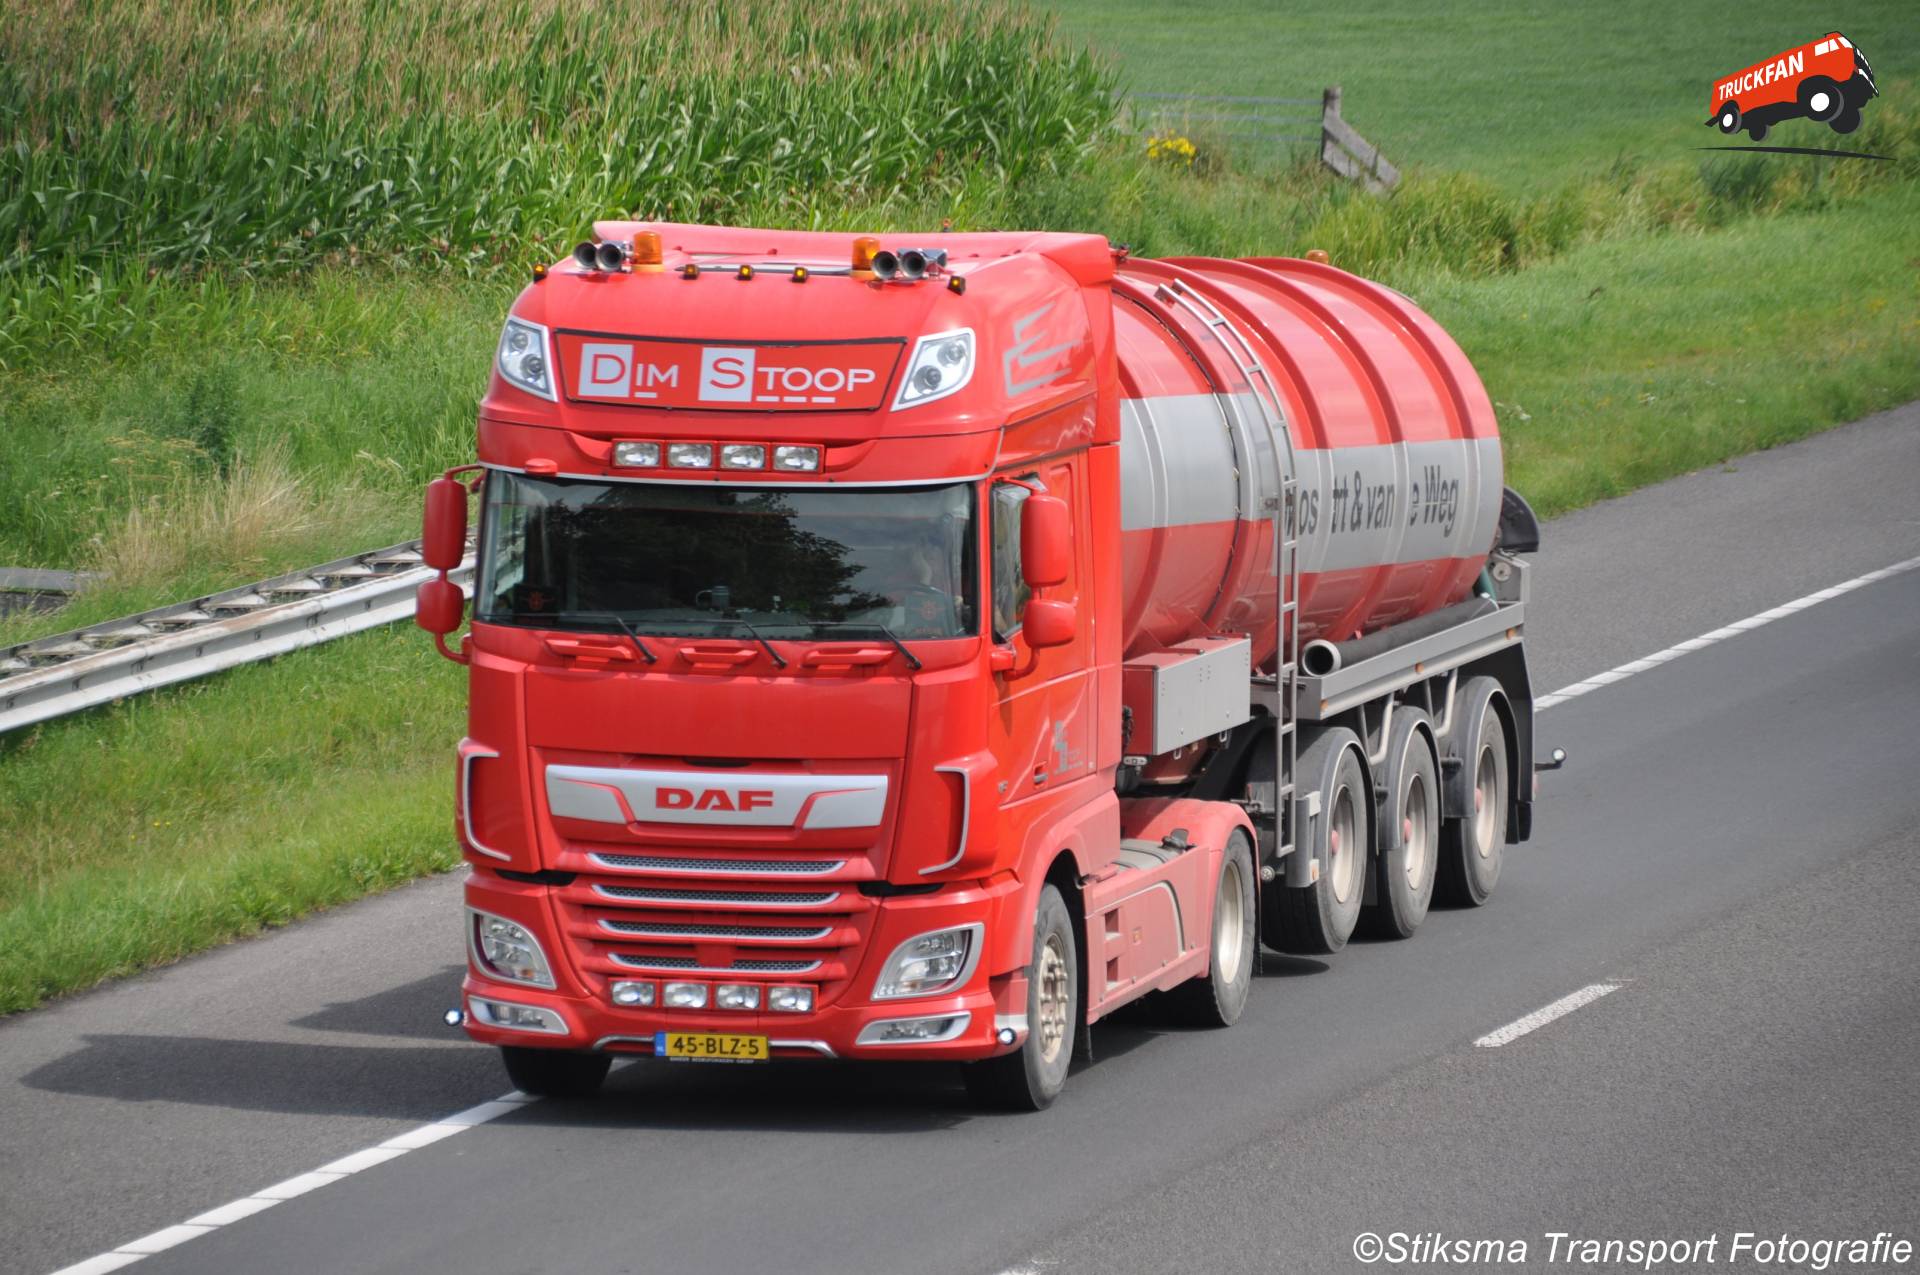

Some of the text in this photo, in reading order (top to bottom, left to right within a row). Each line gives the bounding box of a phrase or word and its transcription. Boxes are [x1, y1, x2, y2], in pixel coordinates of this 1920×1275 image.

[1423, 465, 1460, 538] Weg
[655, 787, 774, 812] DAF
[673, 1036, 760, 1056] 45-BLZ-5
